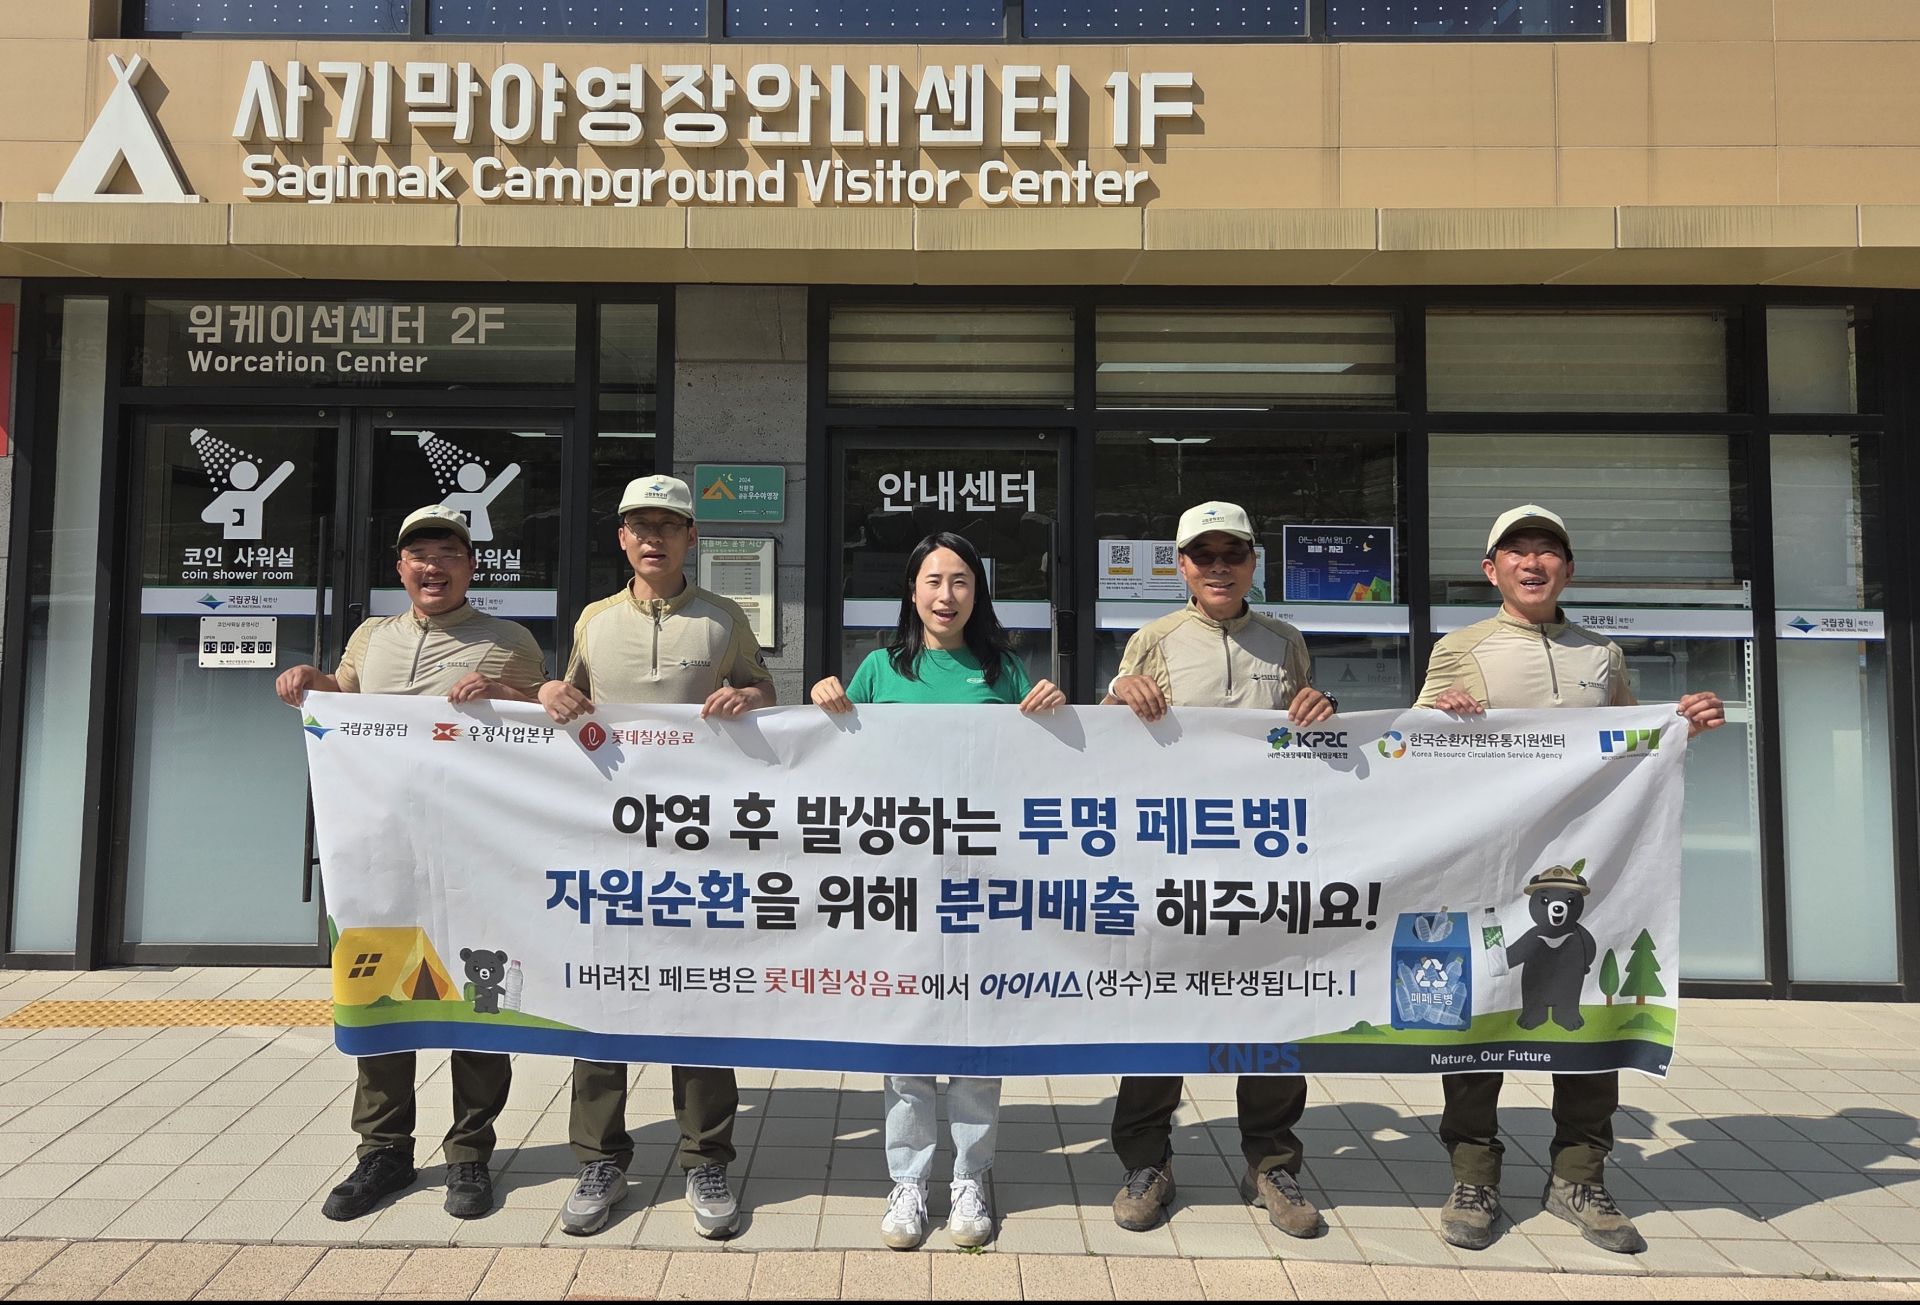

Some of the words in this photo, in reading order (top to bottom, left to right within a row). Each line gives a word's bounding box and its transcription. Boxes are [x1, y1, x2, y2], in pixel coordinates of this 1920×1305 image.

[232, 60, 1071, 149] 사기막야영장안내센터
[1105, 71, 1194, 148] 1F
[242, 154, 457, 205] Sagimak
[473, 156, 786, 207] Campground
[802, 158, 961, 204] Visitor
[978, 160, 1149, 205] Center
[188, 305, 425, 344] 워케이션센터
[451, 307, 505, 344] 2F
[188, 351, 325, 372] Worcation
[336, 351, 428, 373] Center
[878, 470, 1036, 512] 안내센터
[182, 546, 222, 568] 코인
[234, 546, 294, 569] 샤워실
[181, 569, 208, 580] coin
[212, 569, 258, 580] shower
[262, 570, 294, 580] room
[490, 573, 521, 582] room
[227, 595, 259, 604] 국립공원
[469, 597, 484, 606] 공원
[1582, 615, 1614, 625] 국립공원
[1821, 618, 1853, 628] 국립공원
[204, 642, 217, 653] 09
[221, 642, 234, 653] 00
[241, 642, 255, 653] 22
[258, 642, 272, 653] 00
[339, 721, 409, 737] 국립공원공단
[468, 725, 556, 744] 우정사업본부
[610, 729, 695, 745] 롯데칠성음료
[1409, 733, 1566, 749] 한국순환자원유통지원센터
[1535, 752, 1563, 760] Agency
[611, 793, 711, 851] 야영
[729, 792, 779, 851] 후
[797, 796, 1001, 856] 발생하는
[1019, 797, 1117, 857] 투명
[1135, 797, 1309, 858] 페트병!
[546, 869, 800, 930] 자원순환을
[817, 875, 918, 933] 위해
[935, 876, 1140, 936] 분리배출
[1156, 878, 1382, 936] 해주세요!
[579, 964, 651, 992] 버려진
[658, 966, 758, 994] 페트병은
[763, 967, 970, 1000] 롯데칠성음료에서
[979, 969, 1178, 1000] 아이시스(생수)로
[1185, 970, 1344, 998] 재탄생됩니다.
[1206, 1043, 1300, 1073] KNPS
[1430, 1053, 1477, 1065] Nature,
[1480, 1051, 1504, 1062] Our
[1507, 1050, 1551, 1063] Future
